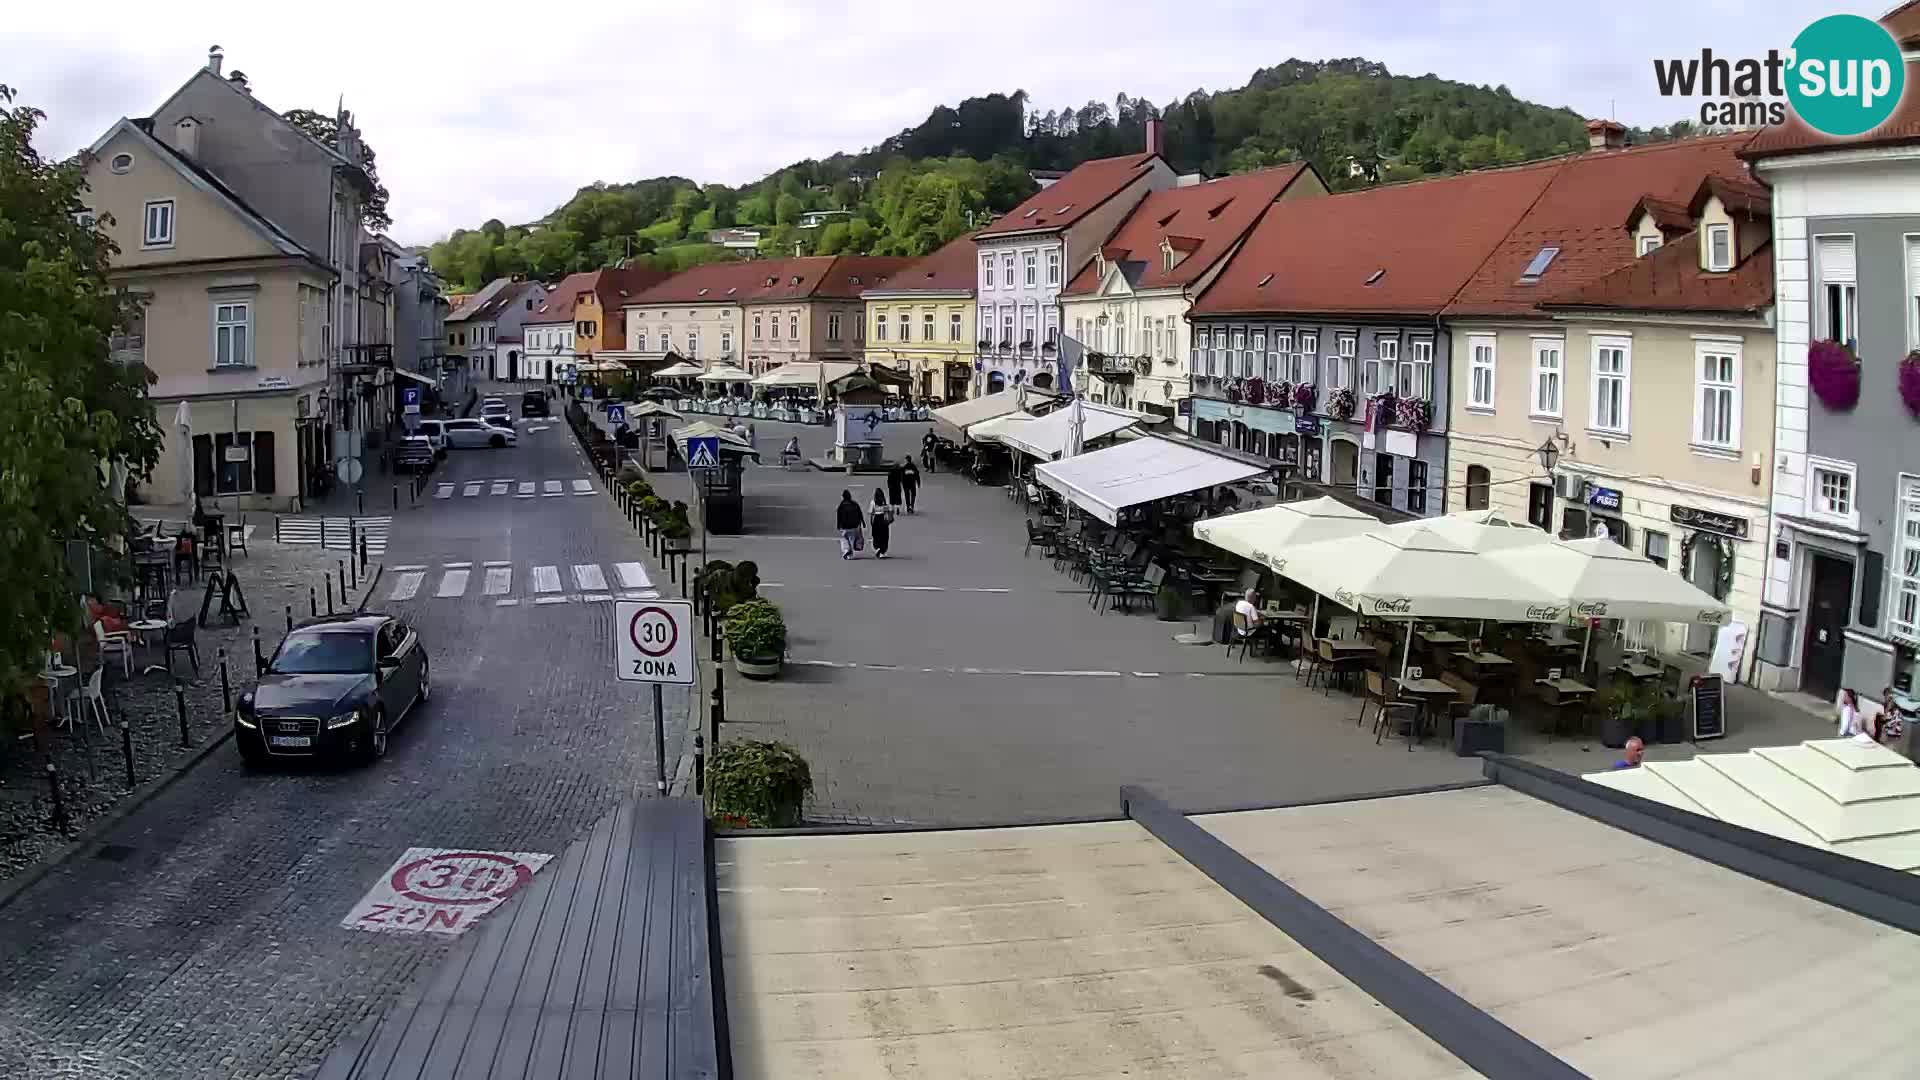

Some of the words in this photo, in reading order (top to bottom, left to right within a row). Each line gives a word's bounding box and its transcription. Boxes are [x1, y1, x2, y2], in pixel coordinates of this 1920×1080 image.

[407, 391, 416, 403] P
[642, 622, 666, 643] 30
[633, 659, 677, 676] ZONA
[419, 864, 504, 892] 30
